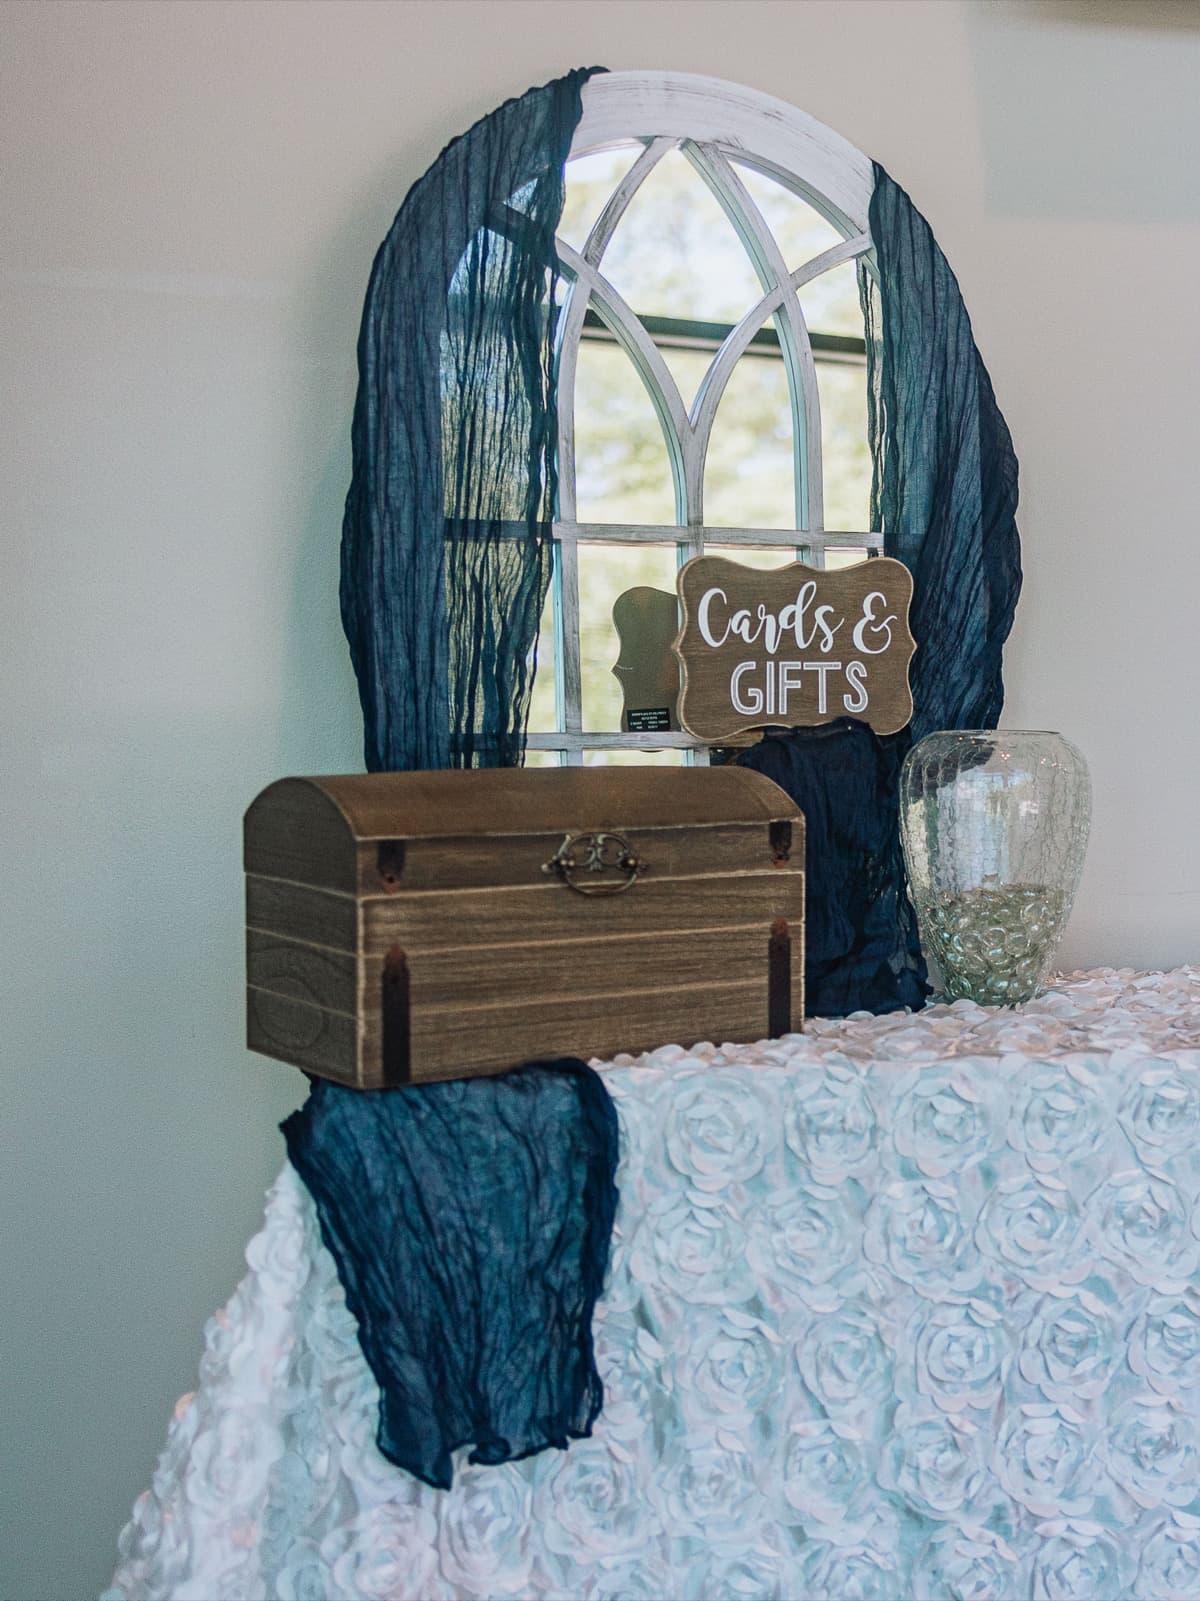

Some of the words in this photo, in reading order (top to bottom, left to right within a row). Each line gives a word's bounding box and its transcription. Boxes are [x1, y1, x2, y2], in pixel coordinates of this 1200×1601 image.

[697, 580, 845, 655] Cards
[852, 591, 898, 655] &
[729, 660, 869, 716] GIFTS
